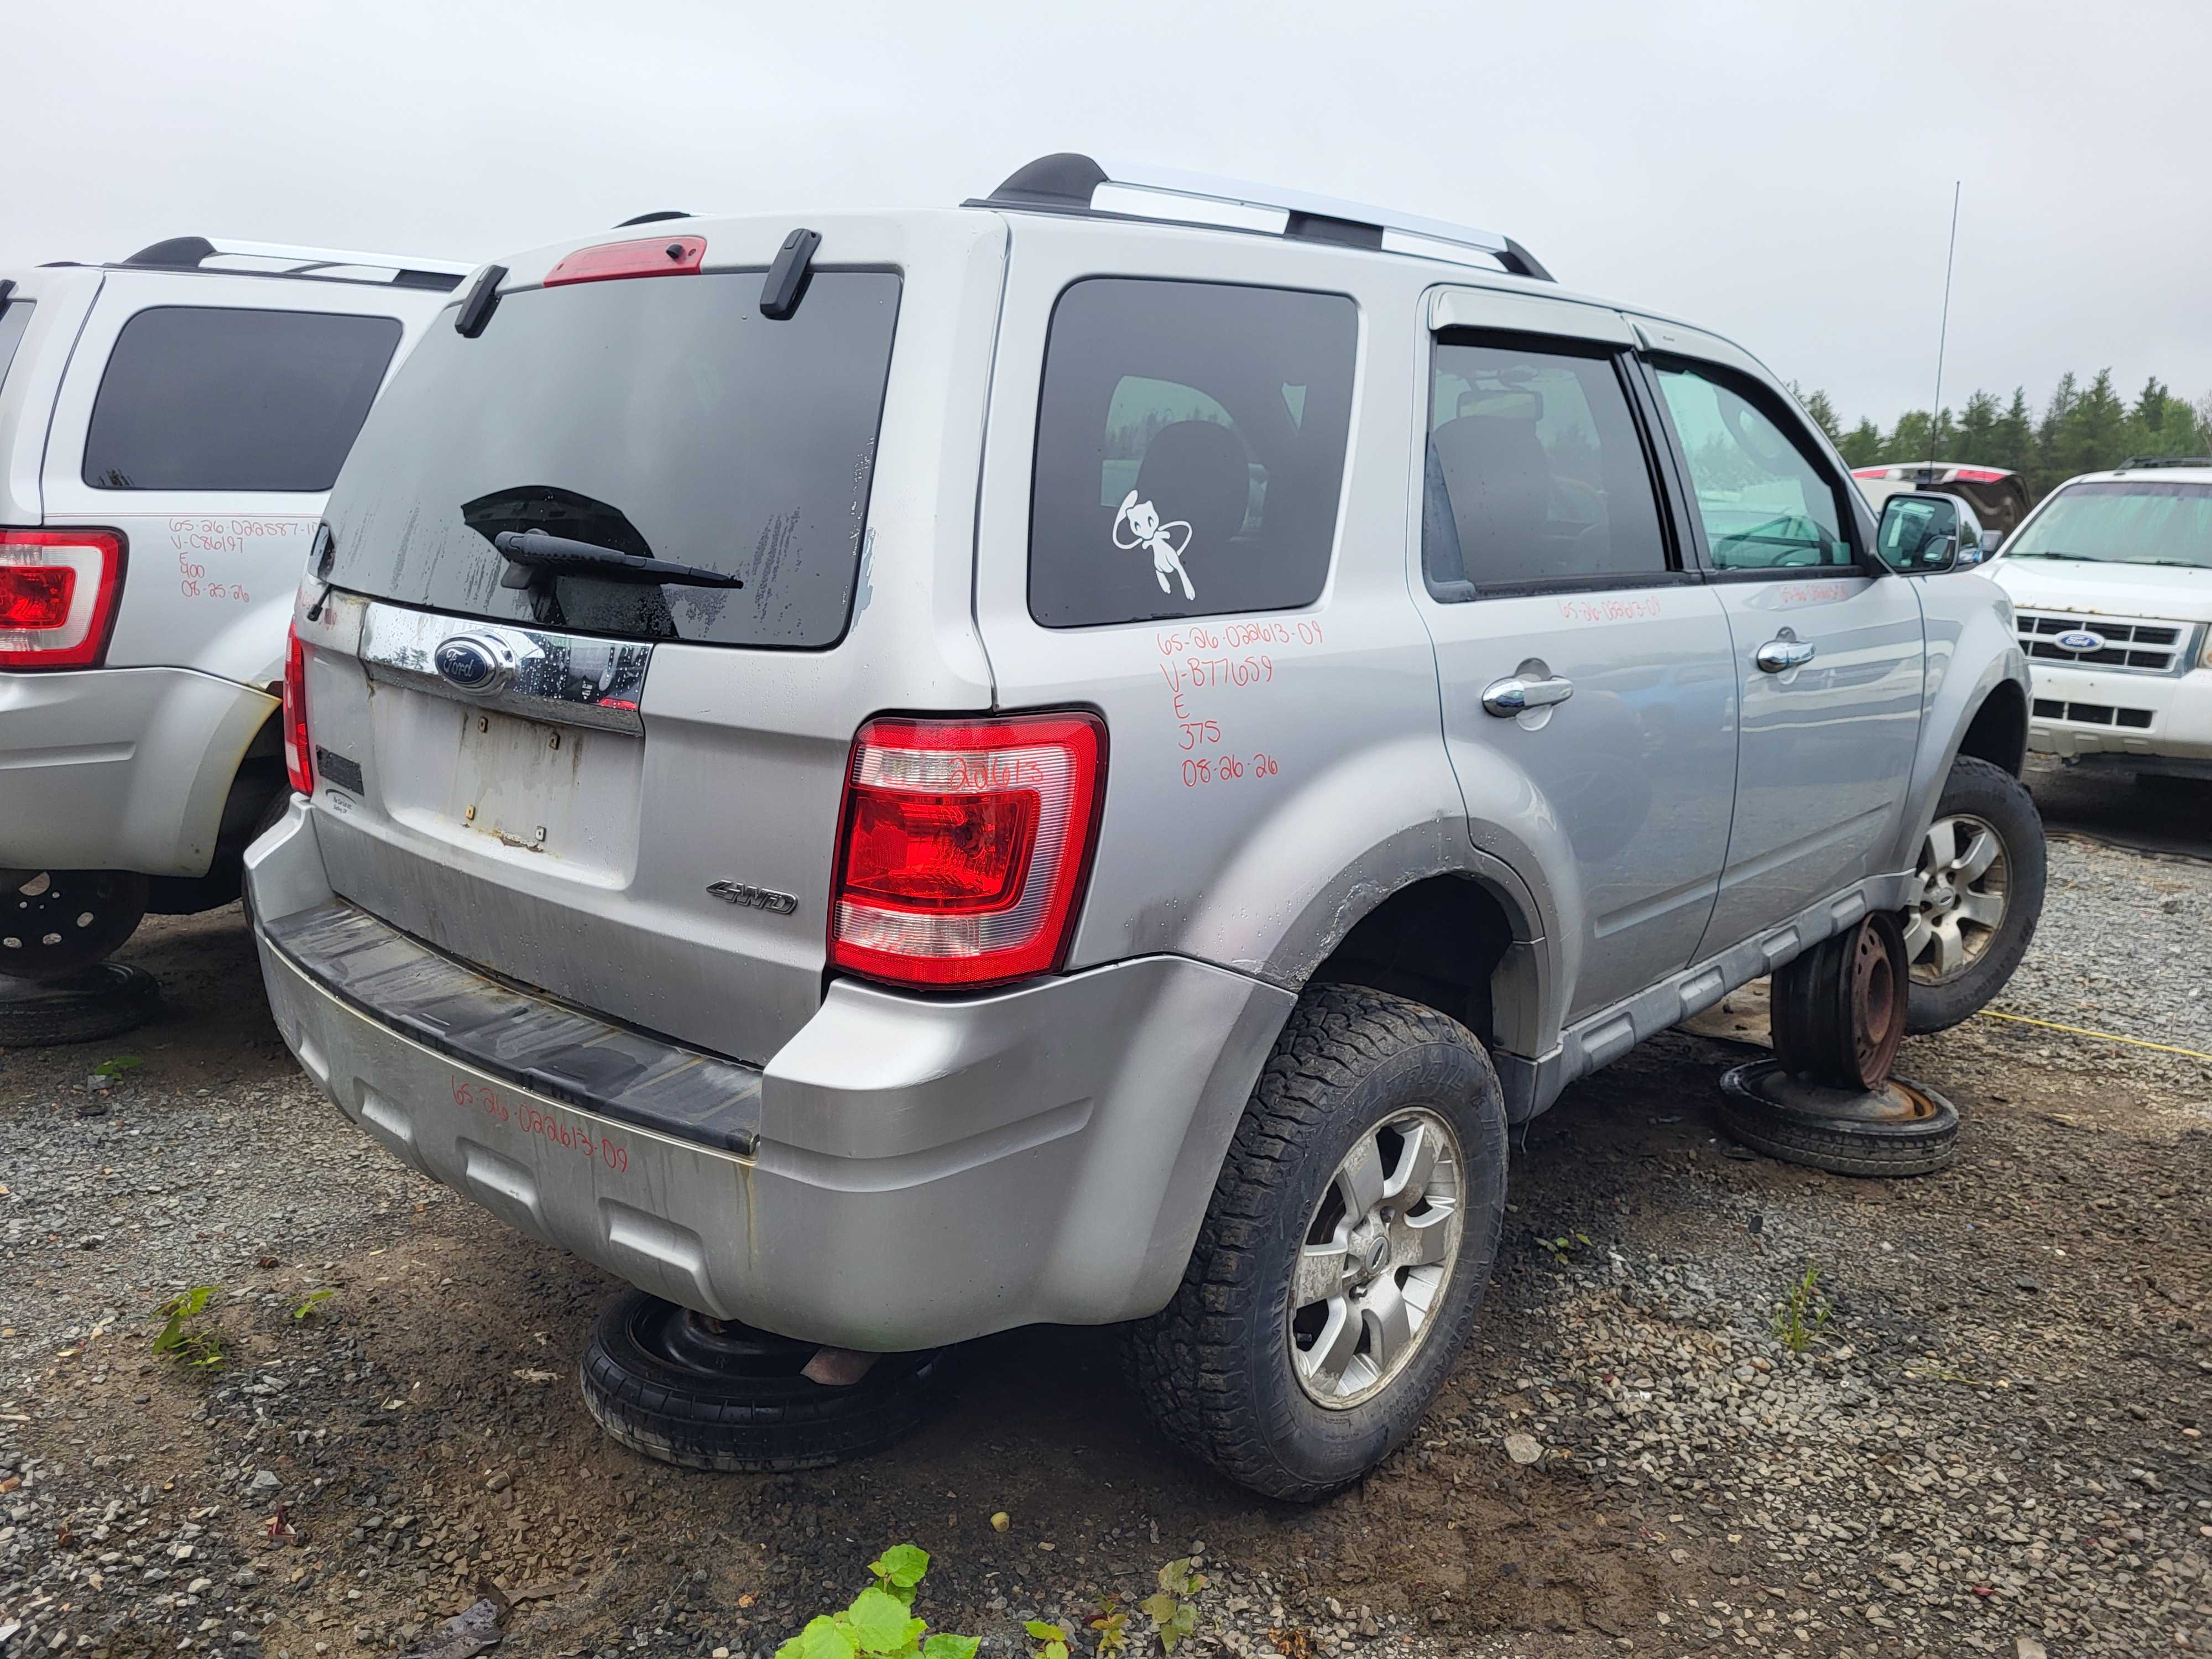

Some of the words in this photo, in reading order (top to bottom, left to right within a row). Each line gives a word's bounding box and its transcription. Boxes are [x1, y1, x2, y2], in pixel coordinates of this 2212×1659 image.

[2065, 634, 2093, 647] Ford
[444, 648, 474, 677] Ford
[1174, 694, 1190, 718] E
[706, 879, 799, 914] 4WD
